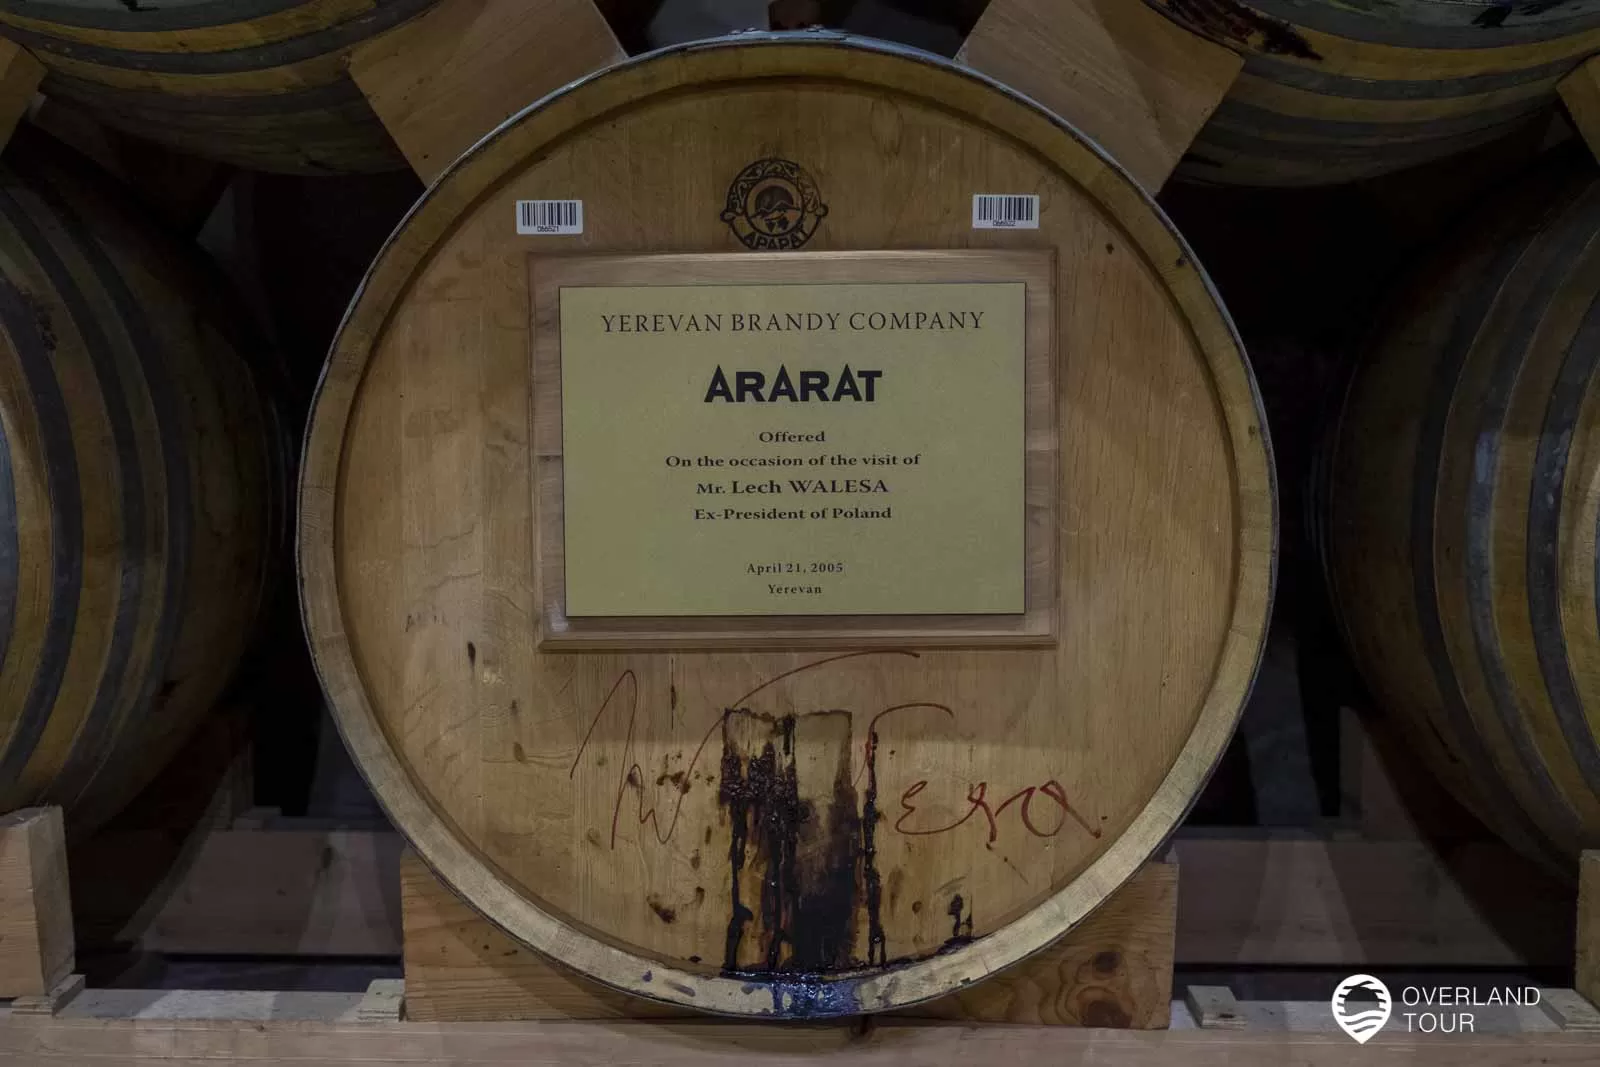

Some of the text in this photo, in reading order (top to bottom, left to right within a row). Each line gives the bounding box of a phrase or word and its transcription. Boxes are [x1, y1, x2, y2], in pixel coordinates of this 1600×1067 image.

[601, 311, 985, 333] YEREVAN BRANDY COMPANY
[704, 363, 883, 403] ARARAT
[759, 431, 826, 443] Offered
[665, 453, 922, 468] On the occasion of the visit of
[696, 479, 890, 495] Mr. Lech WALESA
[694, 506, 892, 521] Ex-President of Poland
[746, 562, 844, 576] April 21, 2005
[767, 583, 822, 595] Yerevan
